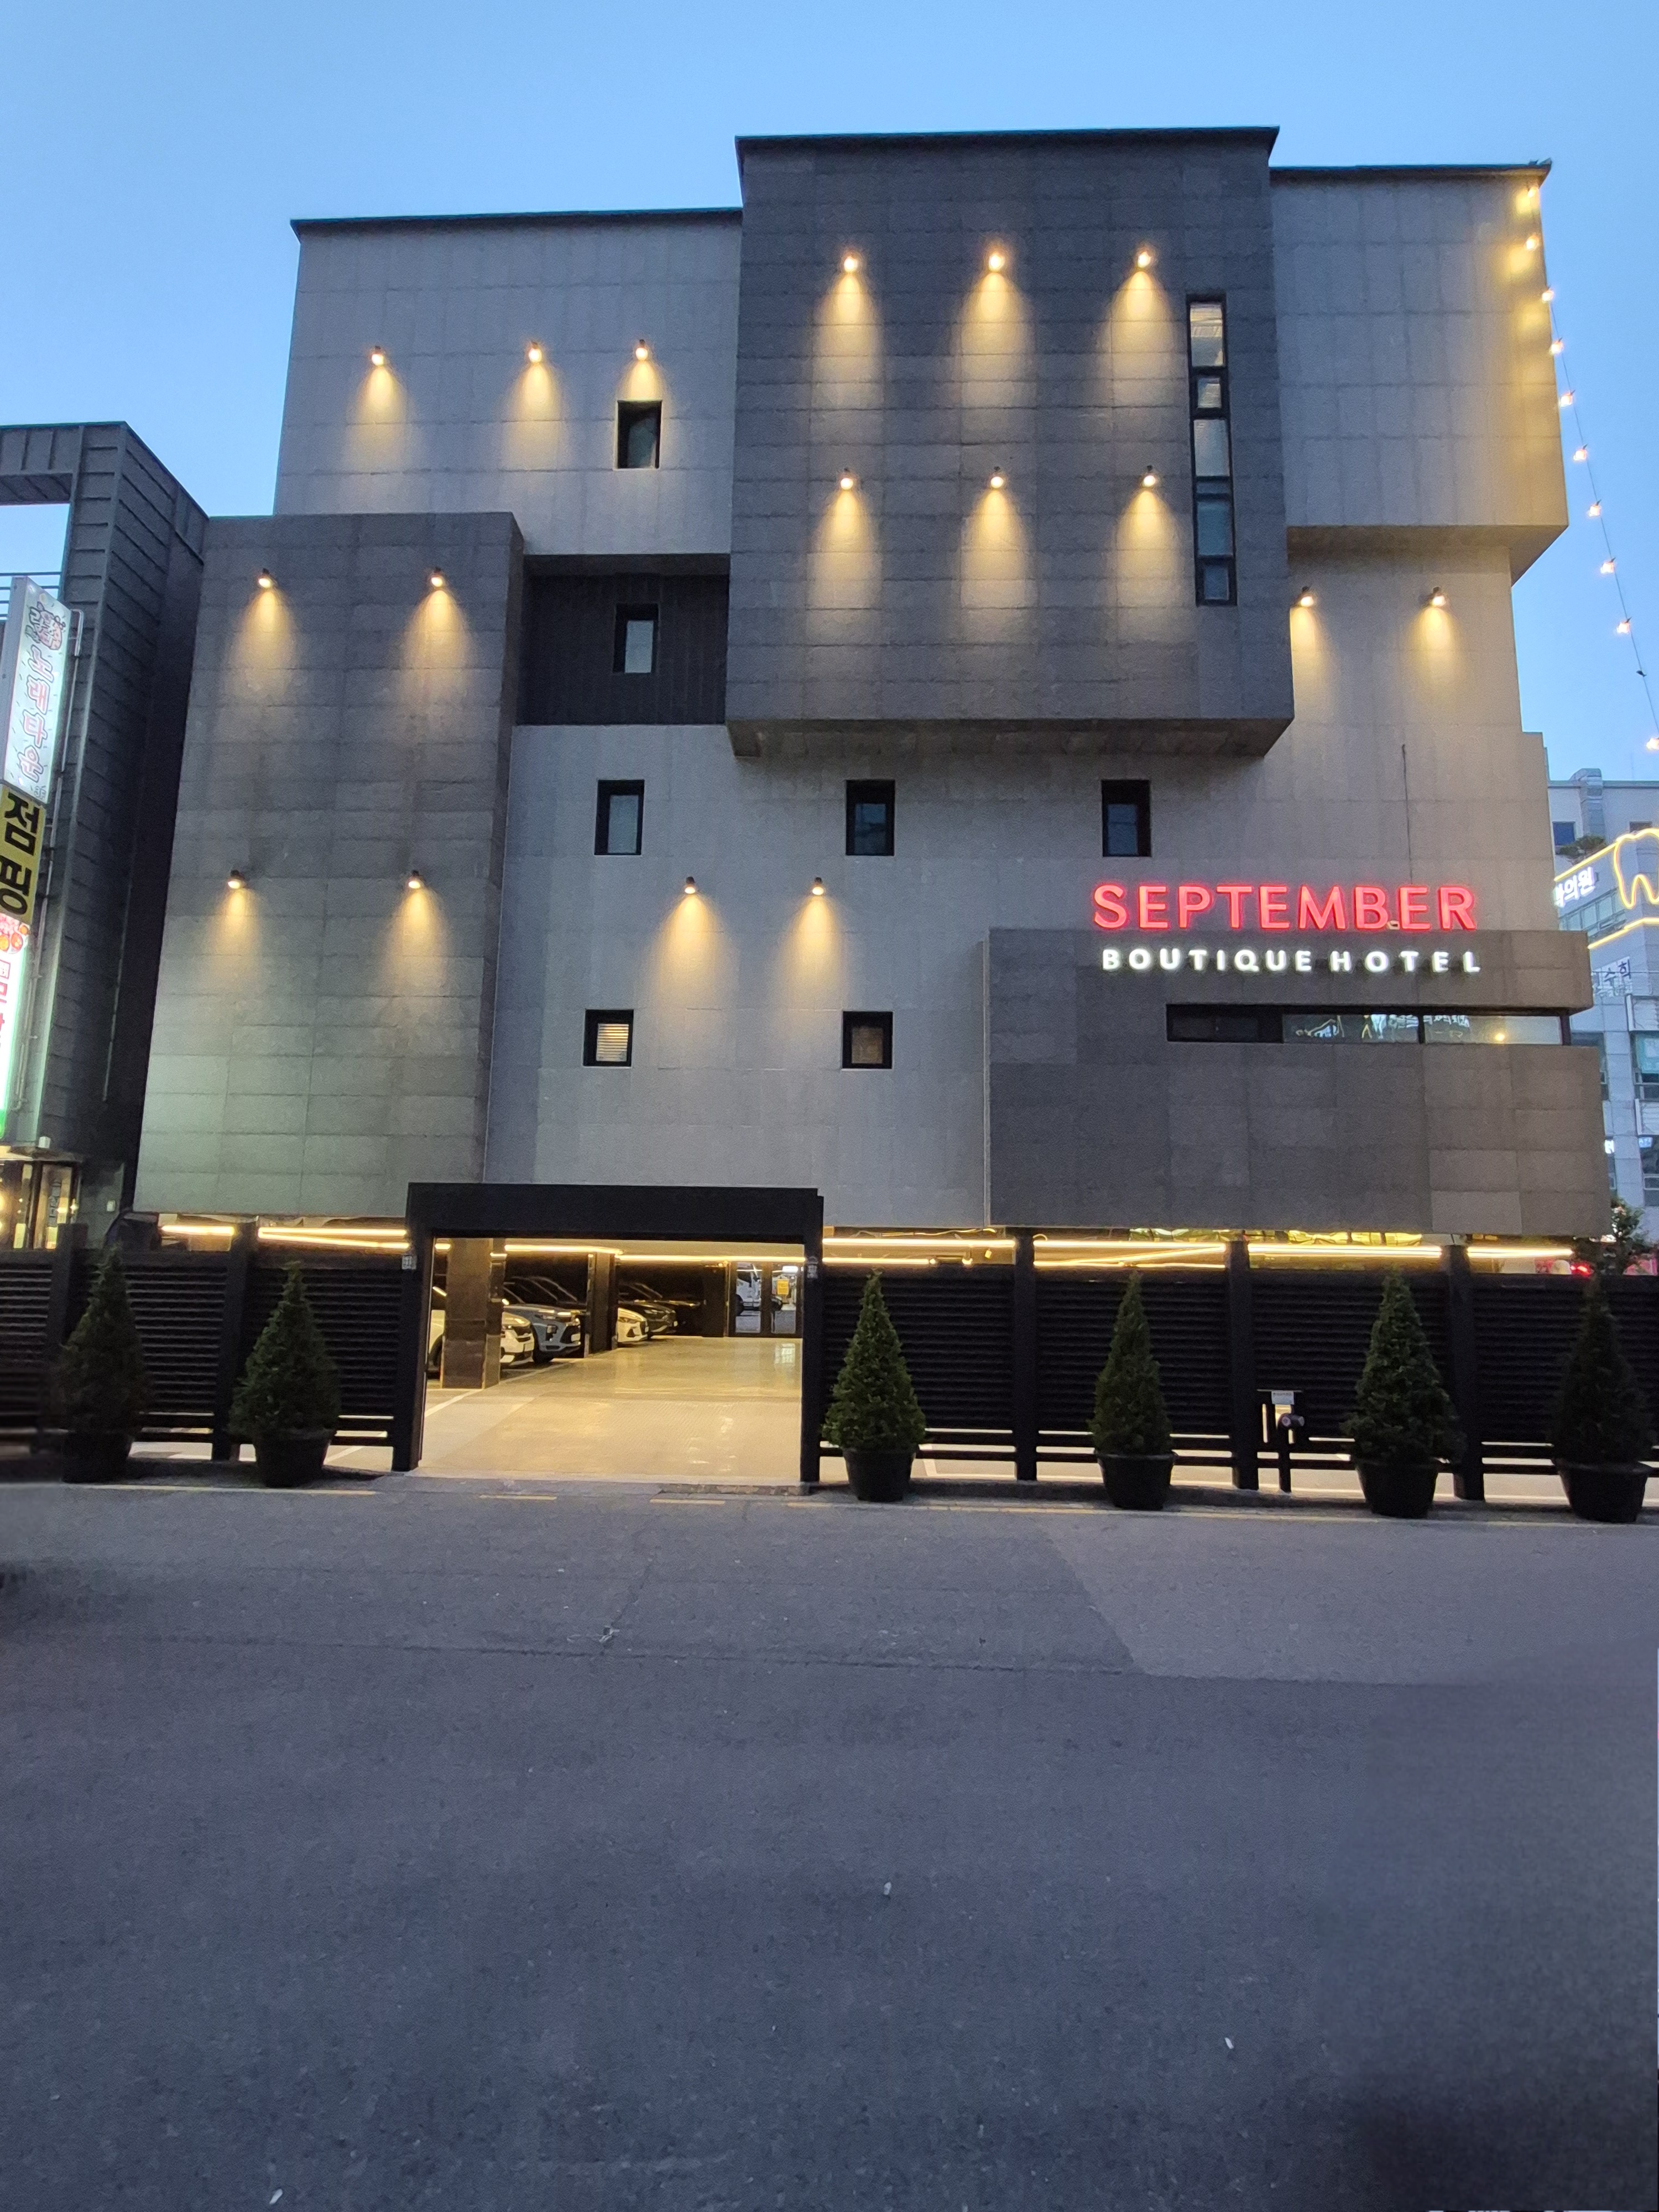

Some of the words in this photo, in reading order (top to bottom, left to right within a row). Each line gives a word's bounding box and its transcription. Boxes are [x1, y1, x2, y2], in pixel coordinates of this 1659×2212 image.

[17, 644, 54, 783] 노래타운
[0, 791, 40, 915] 점핑
[1093, 884, 1477, 930] SEPTEMBER
[1102, 948, 1312, 972] BOUTIQUE
[1329, 950, 1481, 973] HOTEL
